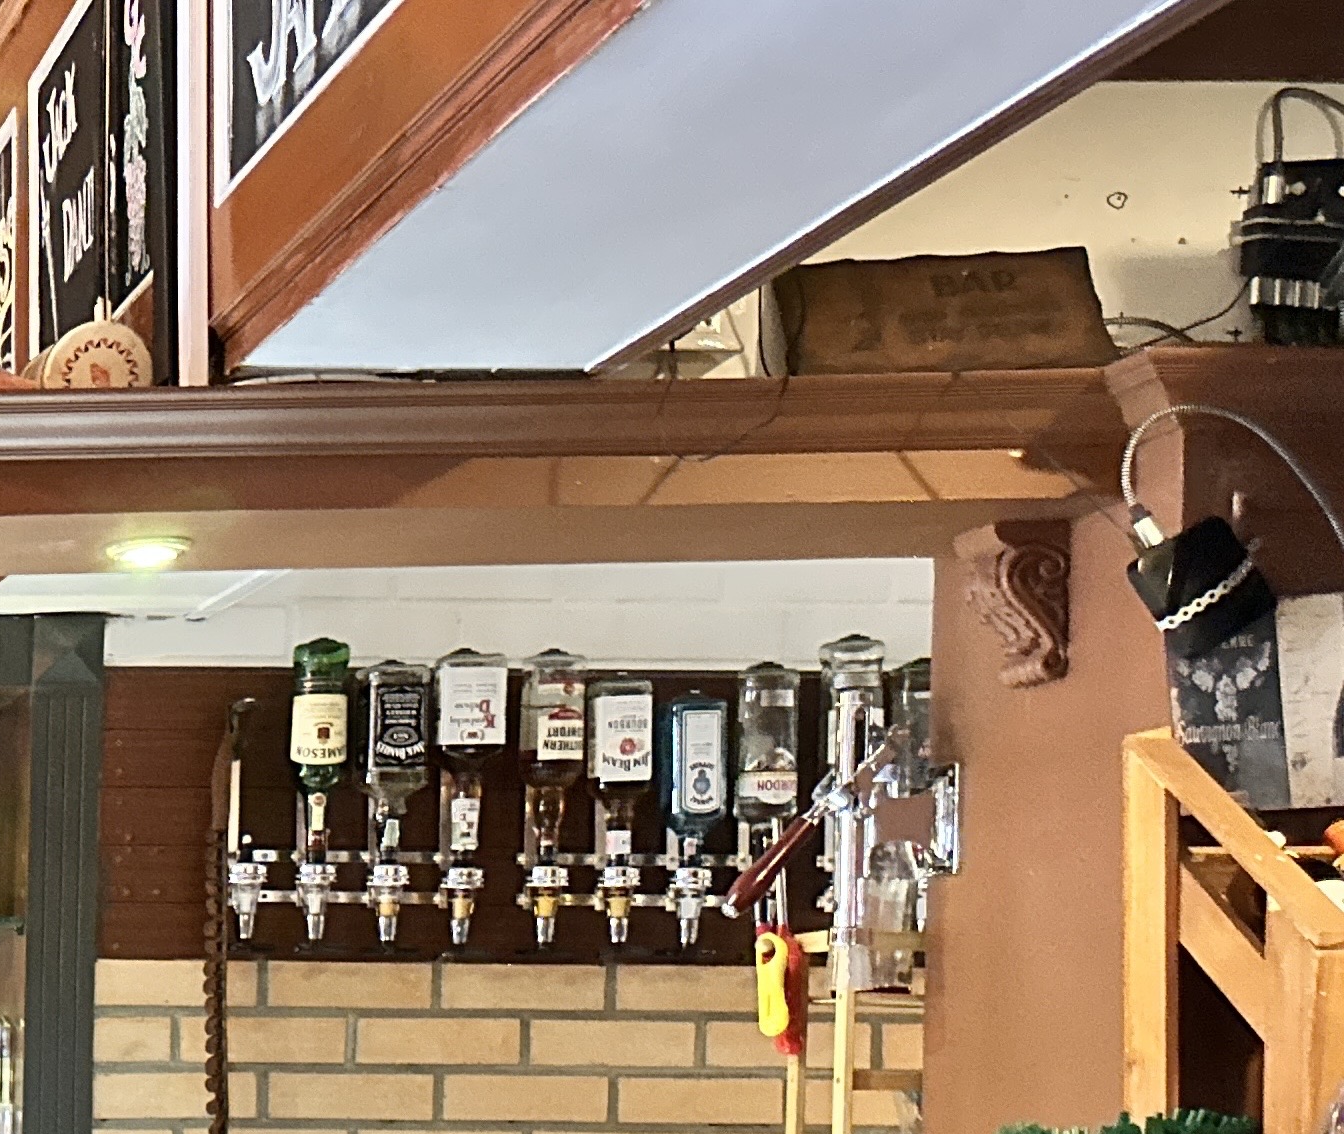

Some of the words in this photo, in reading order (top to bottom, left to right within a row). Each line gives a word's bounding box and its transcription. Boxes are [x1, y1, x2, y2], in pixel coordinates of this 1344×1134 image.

[608, 718, 648, 729] BOURBON
[602, 751, 631, 772] BEAM
[633, 751, 650, 769] JIM
